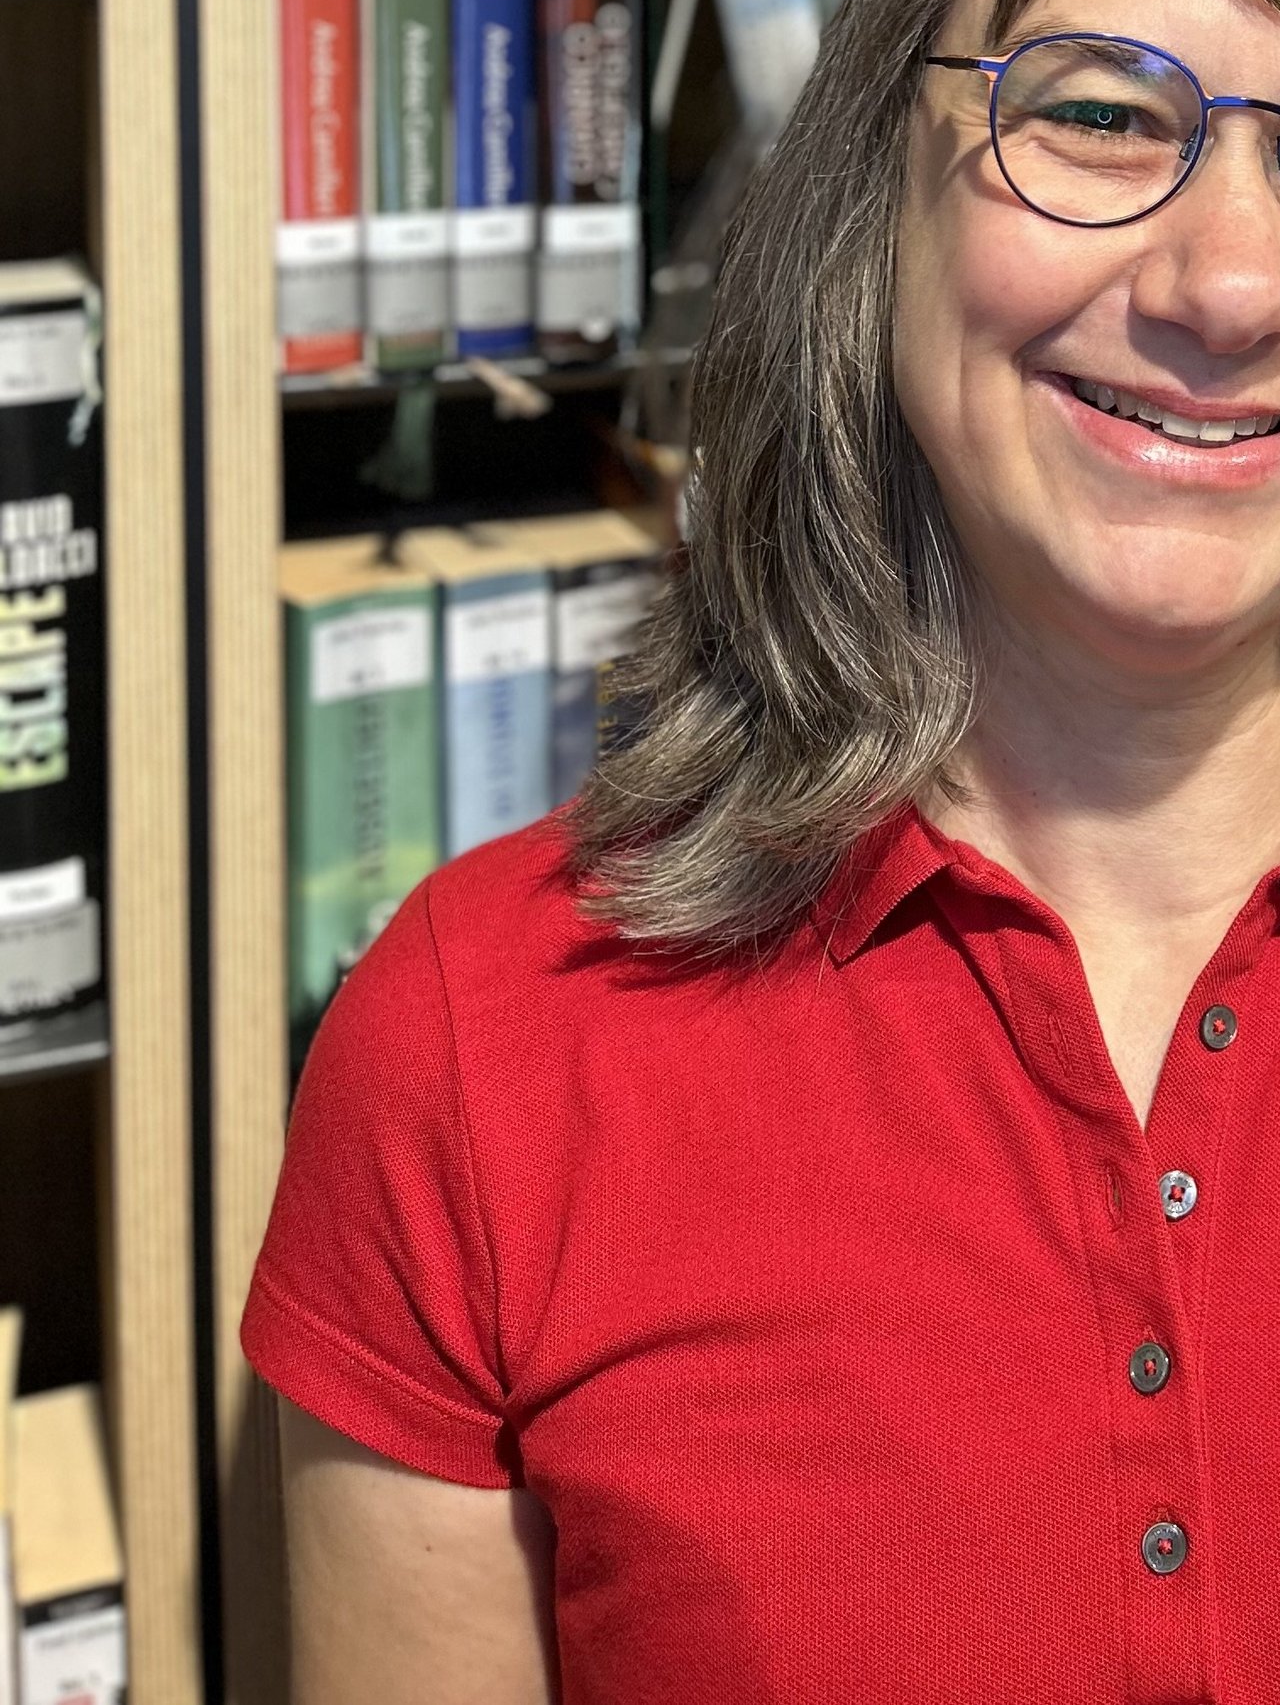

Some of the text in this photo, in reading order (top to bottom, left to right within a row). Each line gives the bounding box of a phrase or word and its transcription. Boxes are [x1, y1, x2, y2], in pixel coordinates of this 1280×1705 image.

[312, 21, 341, 108] Andrea
[405, 23, 433, 110] Andrea
[483, 25, 514, 111] Andrea
[484, 113, 514, 210] Camiller
[0, 585, 68, 790] ESCAPE
